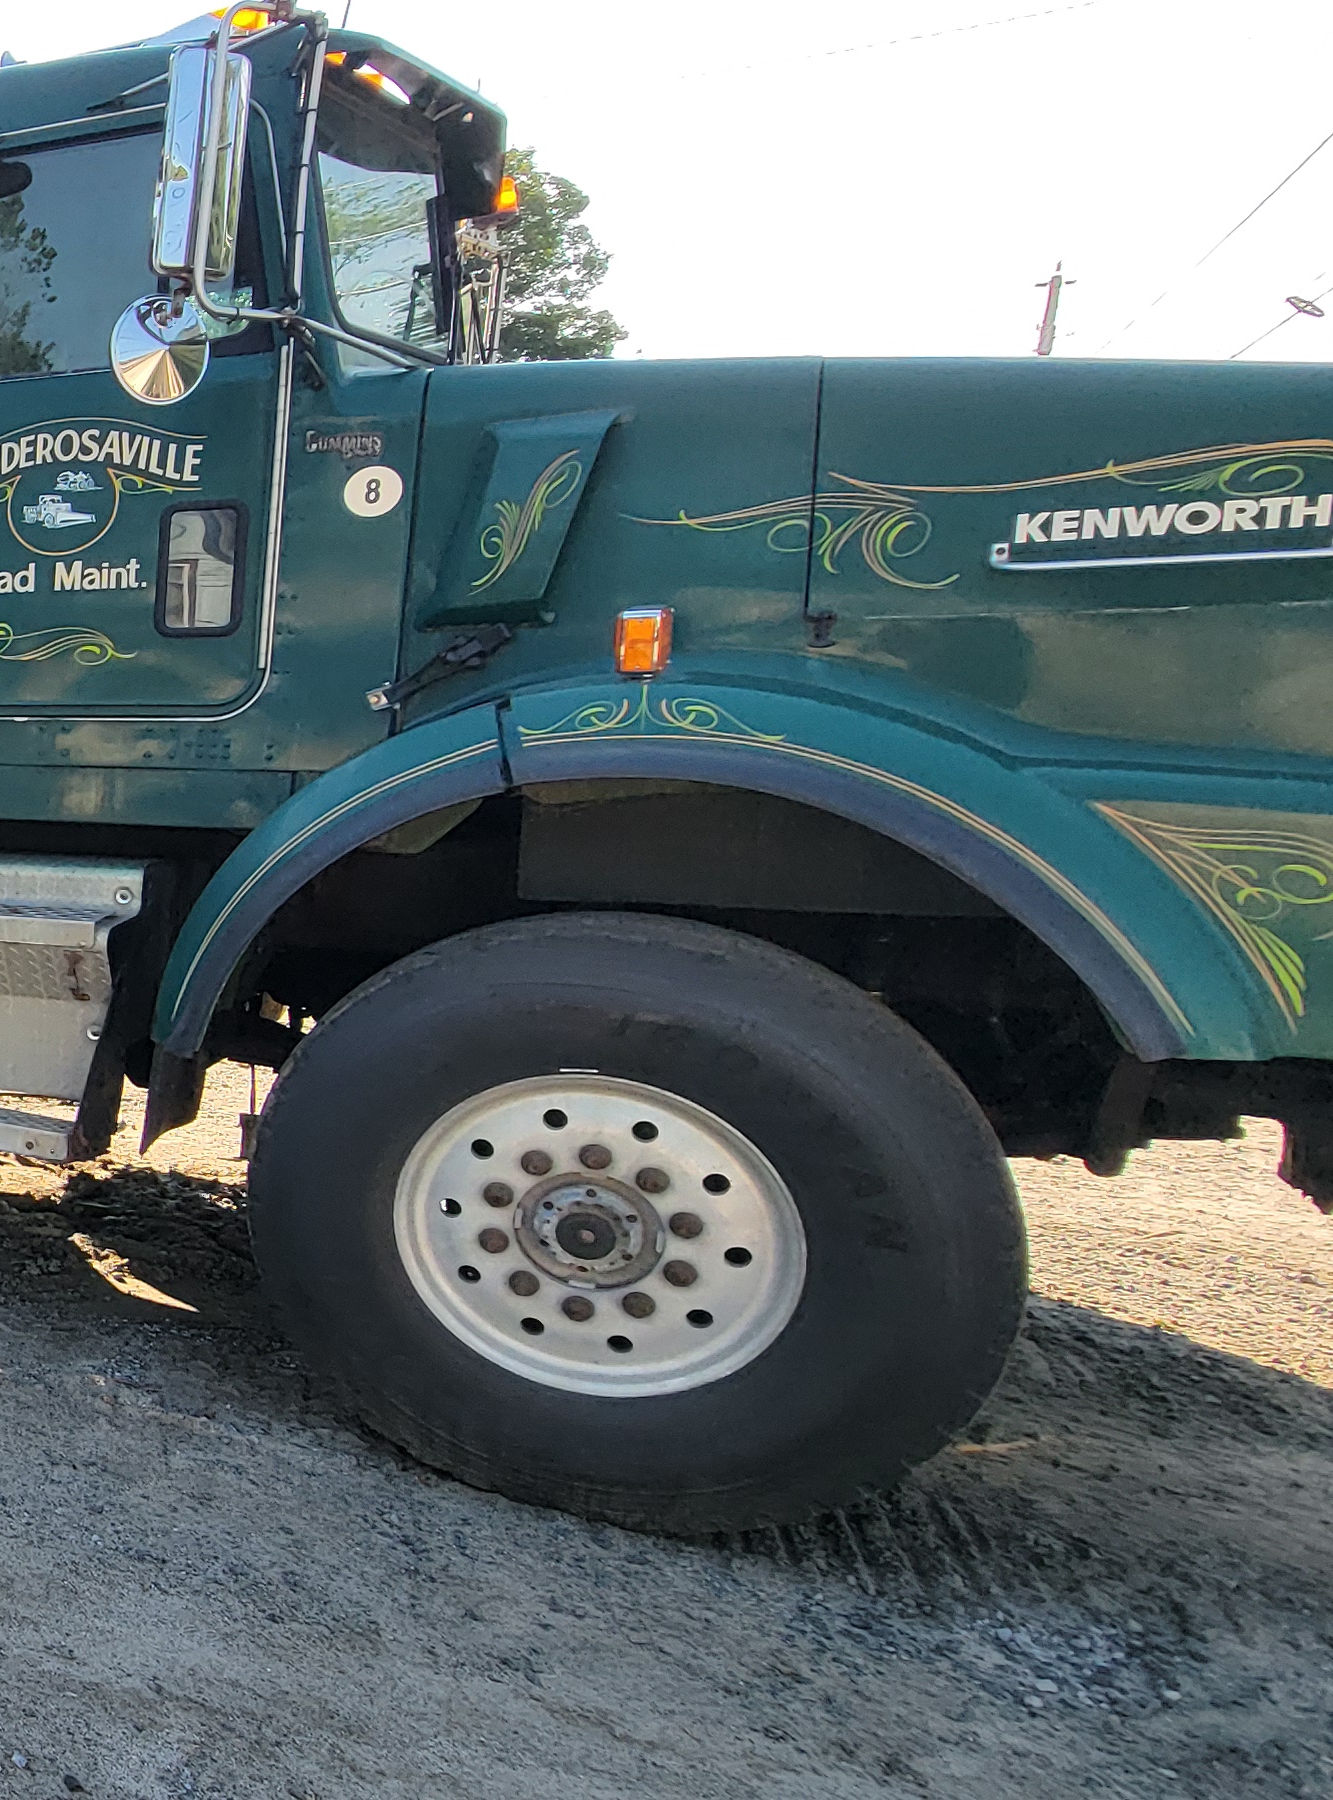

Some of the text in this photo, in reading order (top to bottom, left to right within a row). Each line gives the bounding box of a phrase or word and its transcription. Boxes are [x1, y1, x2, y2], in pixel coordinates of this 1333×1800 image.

[365, 478, 381, 504] 8
[1014, 494, 1332, 543] KENWORTH
[53, 559, 147, 591] Maint.
